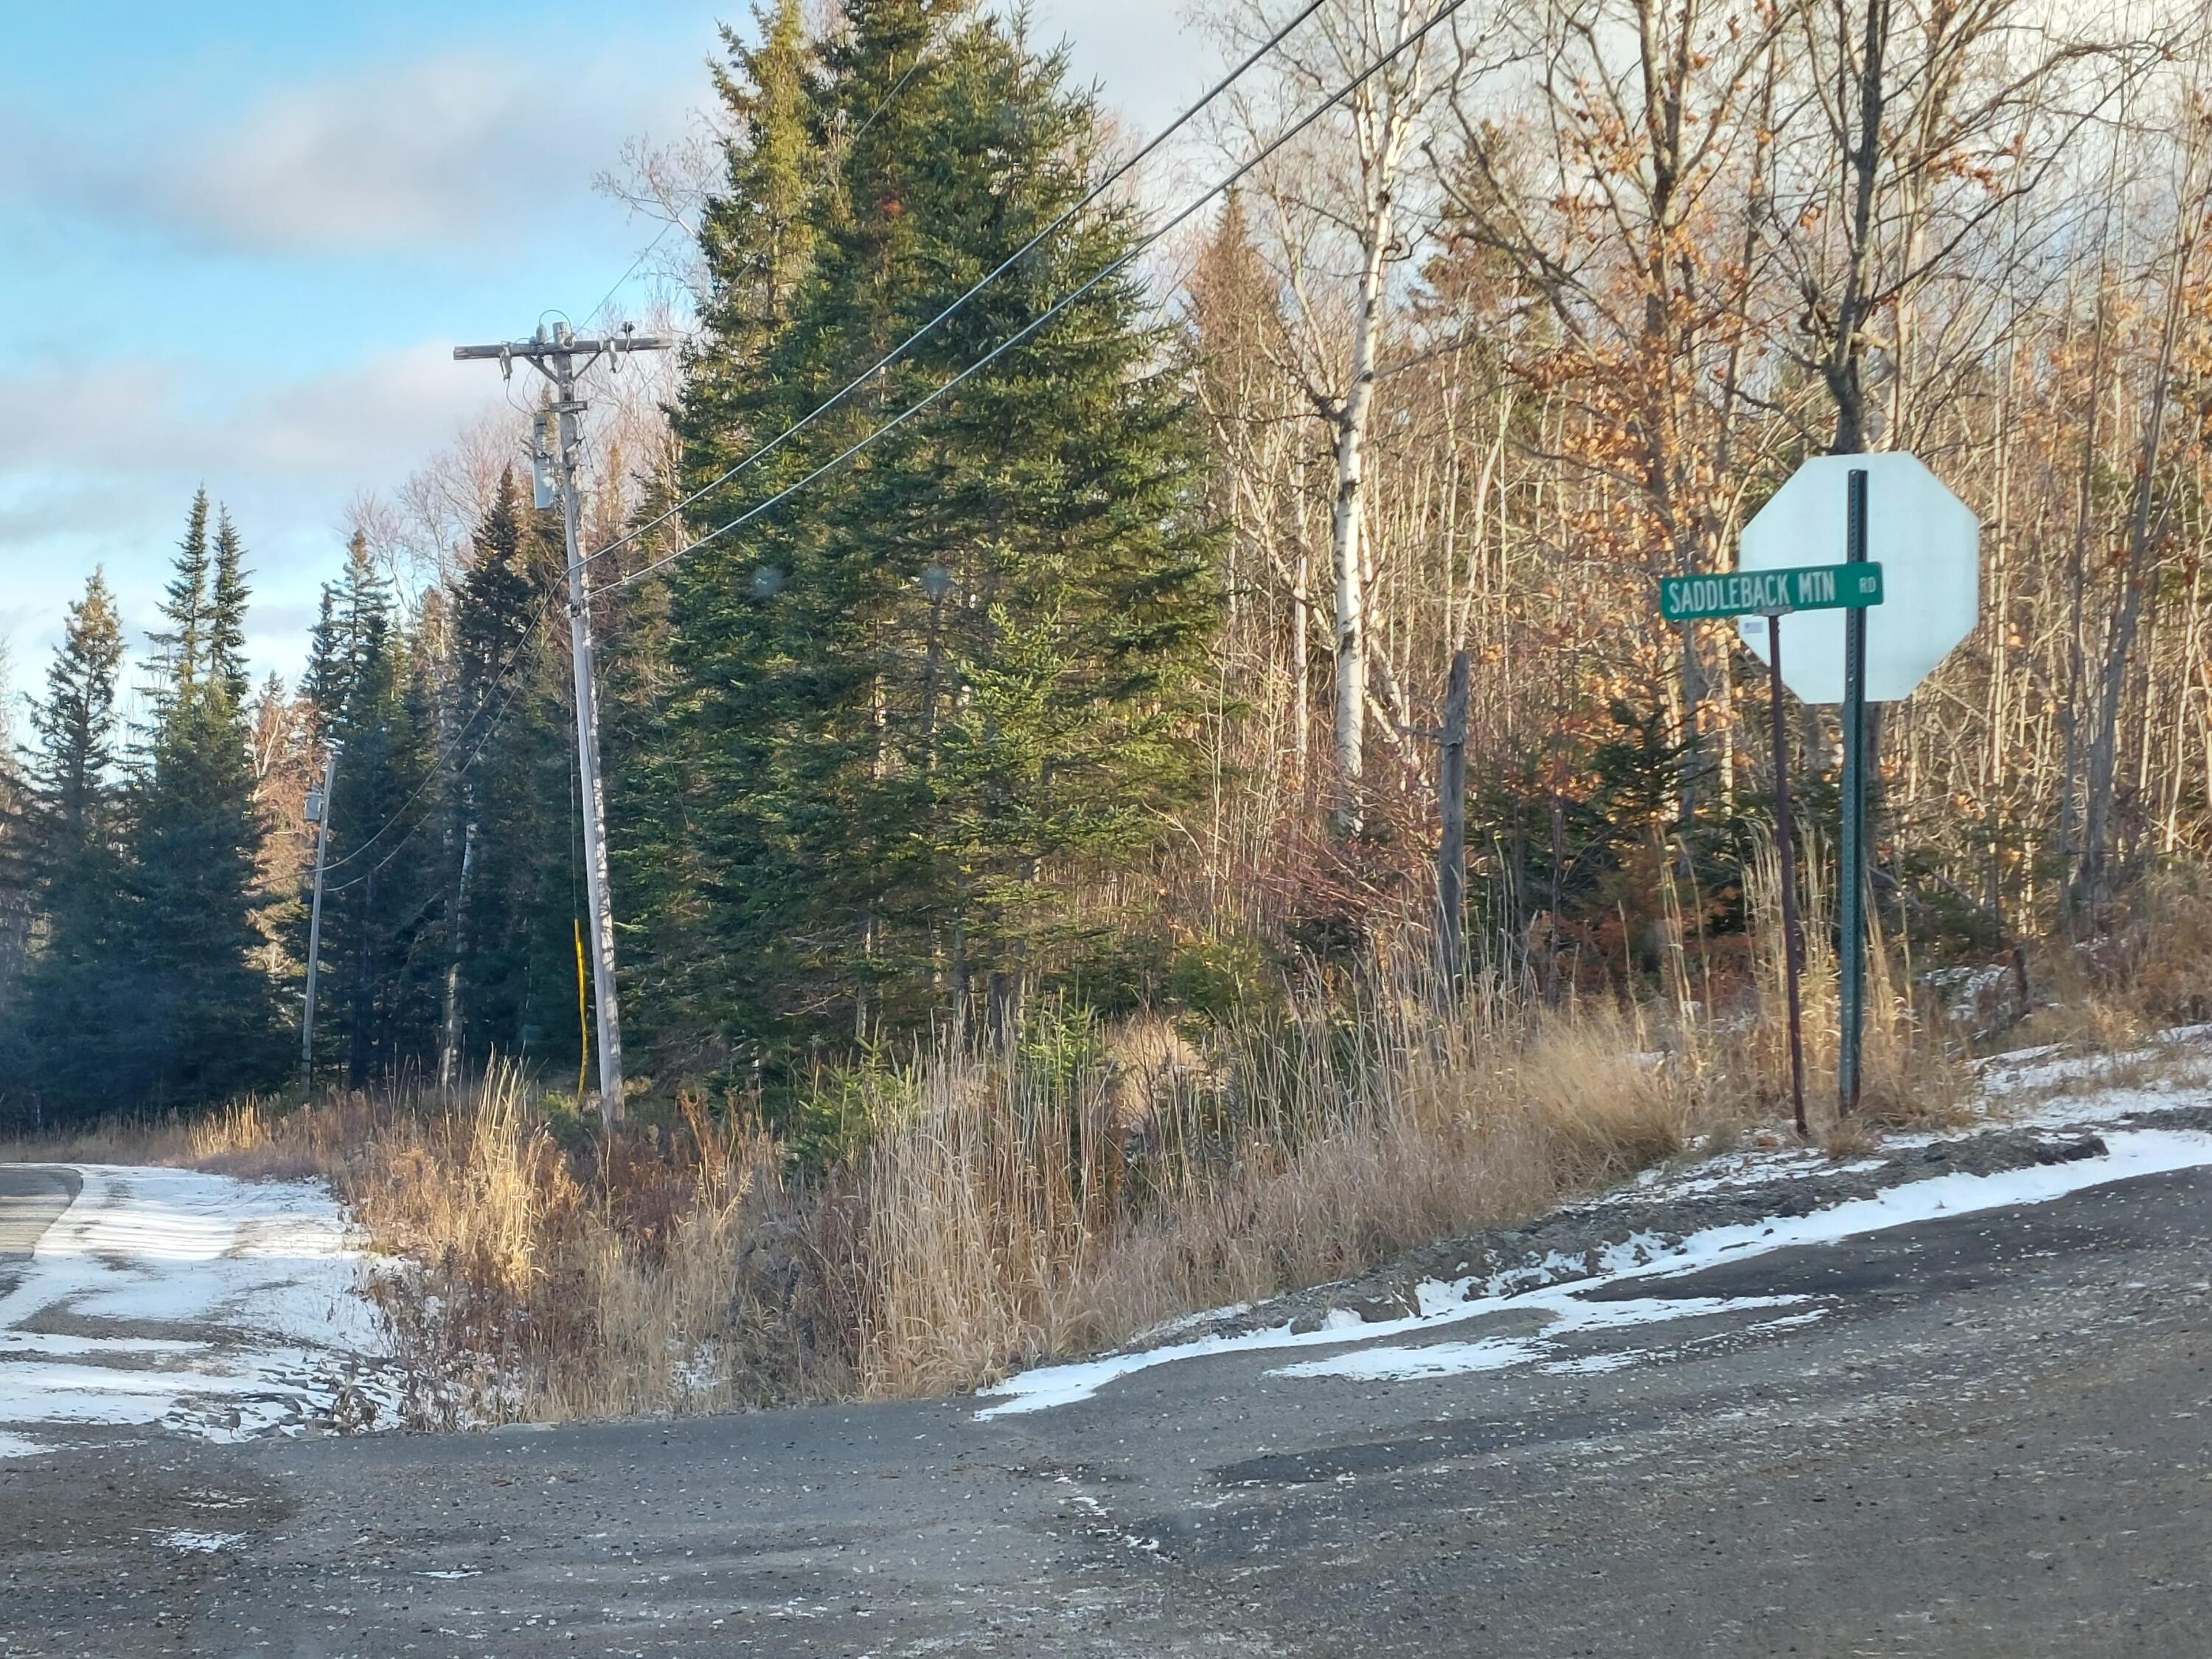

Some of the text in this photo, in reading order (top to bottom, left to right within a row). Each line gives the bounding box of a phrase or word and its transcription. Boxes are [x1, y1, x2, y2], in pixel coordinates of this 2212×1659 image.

[1669, 571, 1877, 613] SADDLEBACK MTN RD
